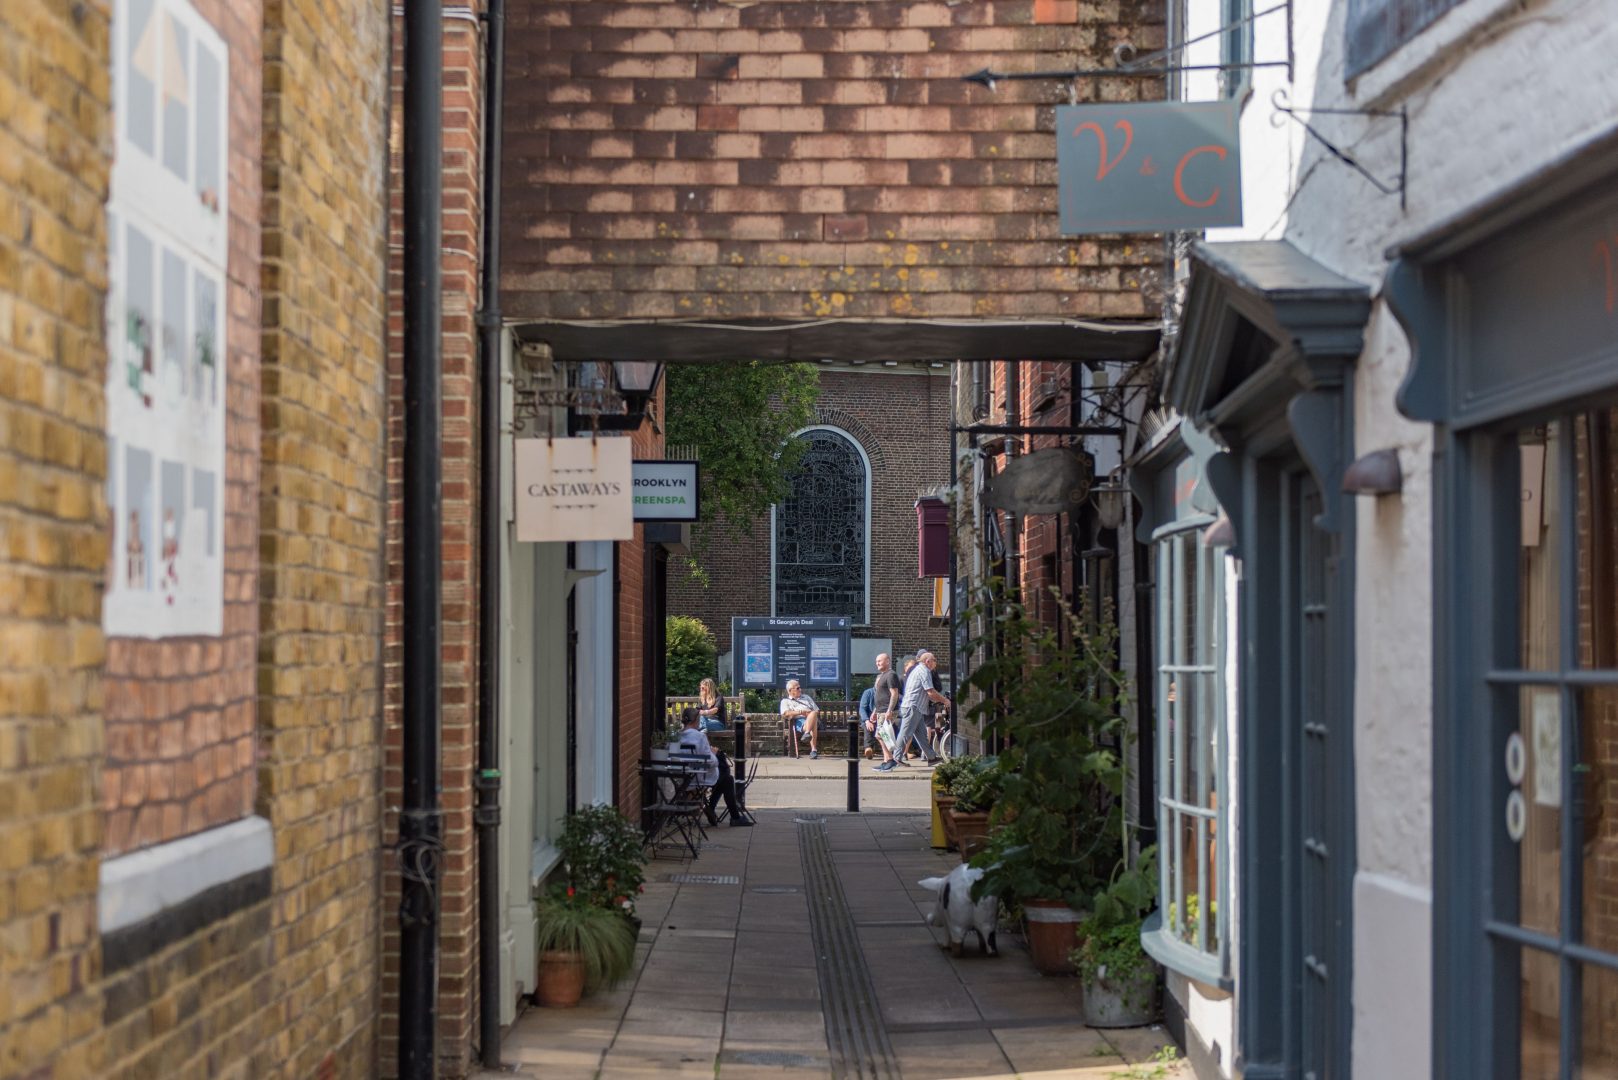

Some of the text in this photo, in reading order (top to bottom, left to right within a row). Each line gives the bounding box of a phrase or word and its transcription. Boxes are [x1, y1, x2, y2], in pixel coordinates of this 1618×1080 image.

[1072, 119, 1228, 208] V & C
[632, 478, 687, 487] ROOKLYN
[527, 482, 621, 497] CASTAWAYS
[632, 495, 687, 504] REENSPA
